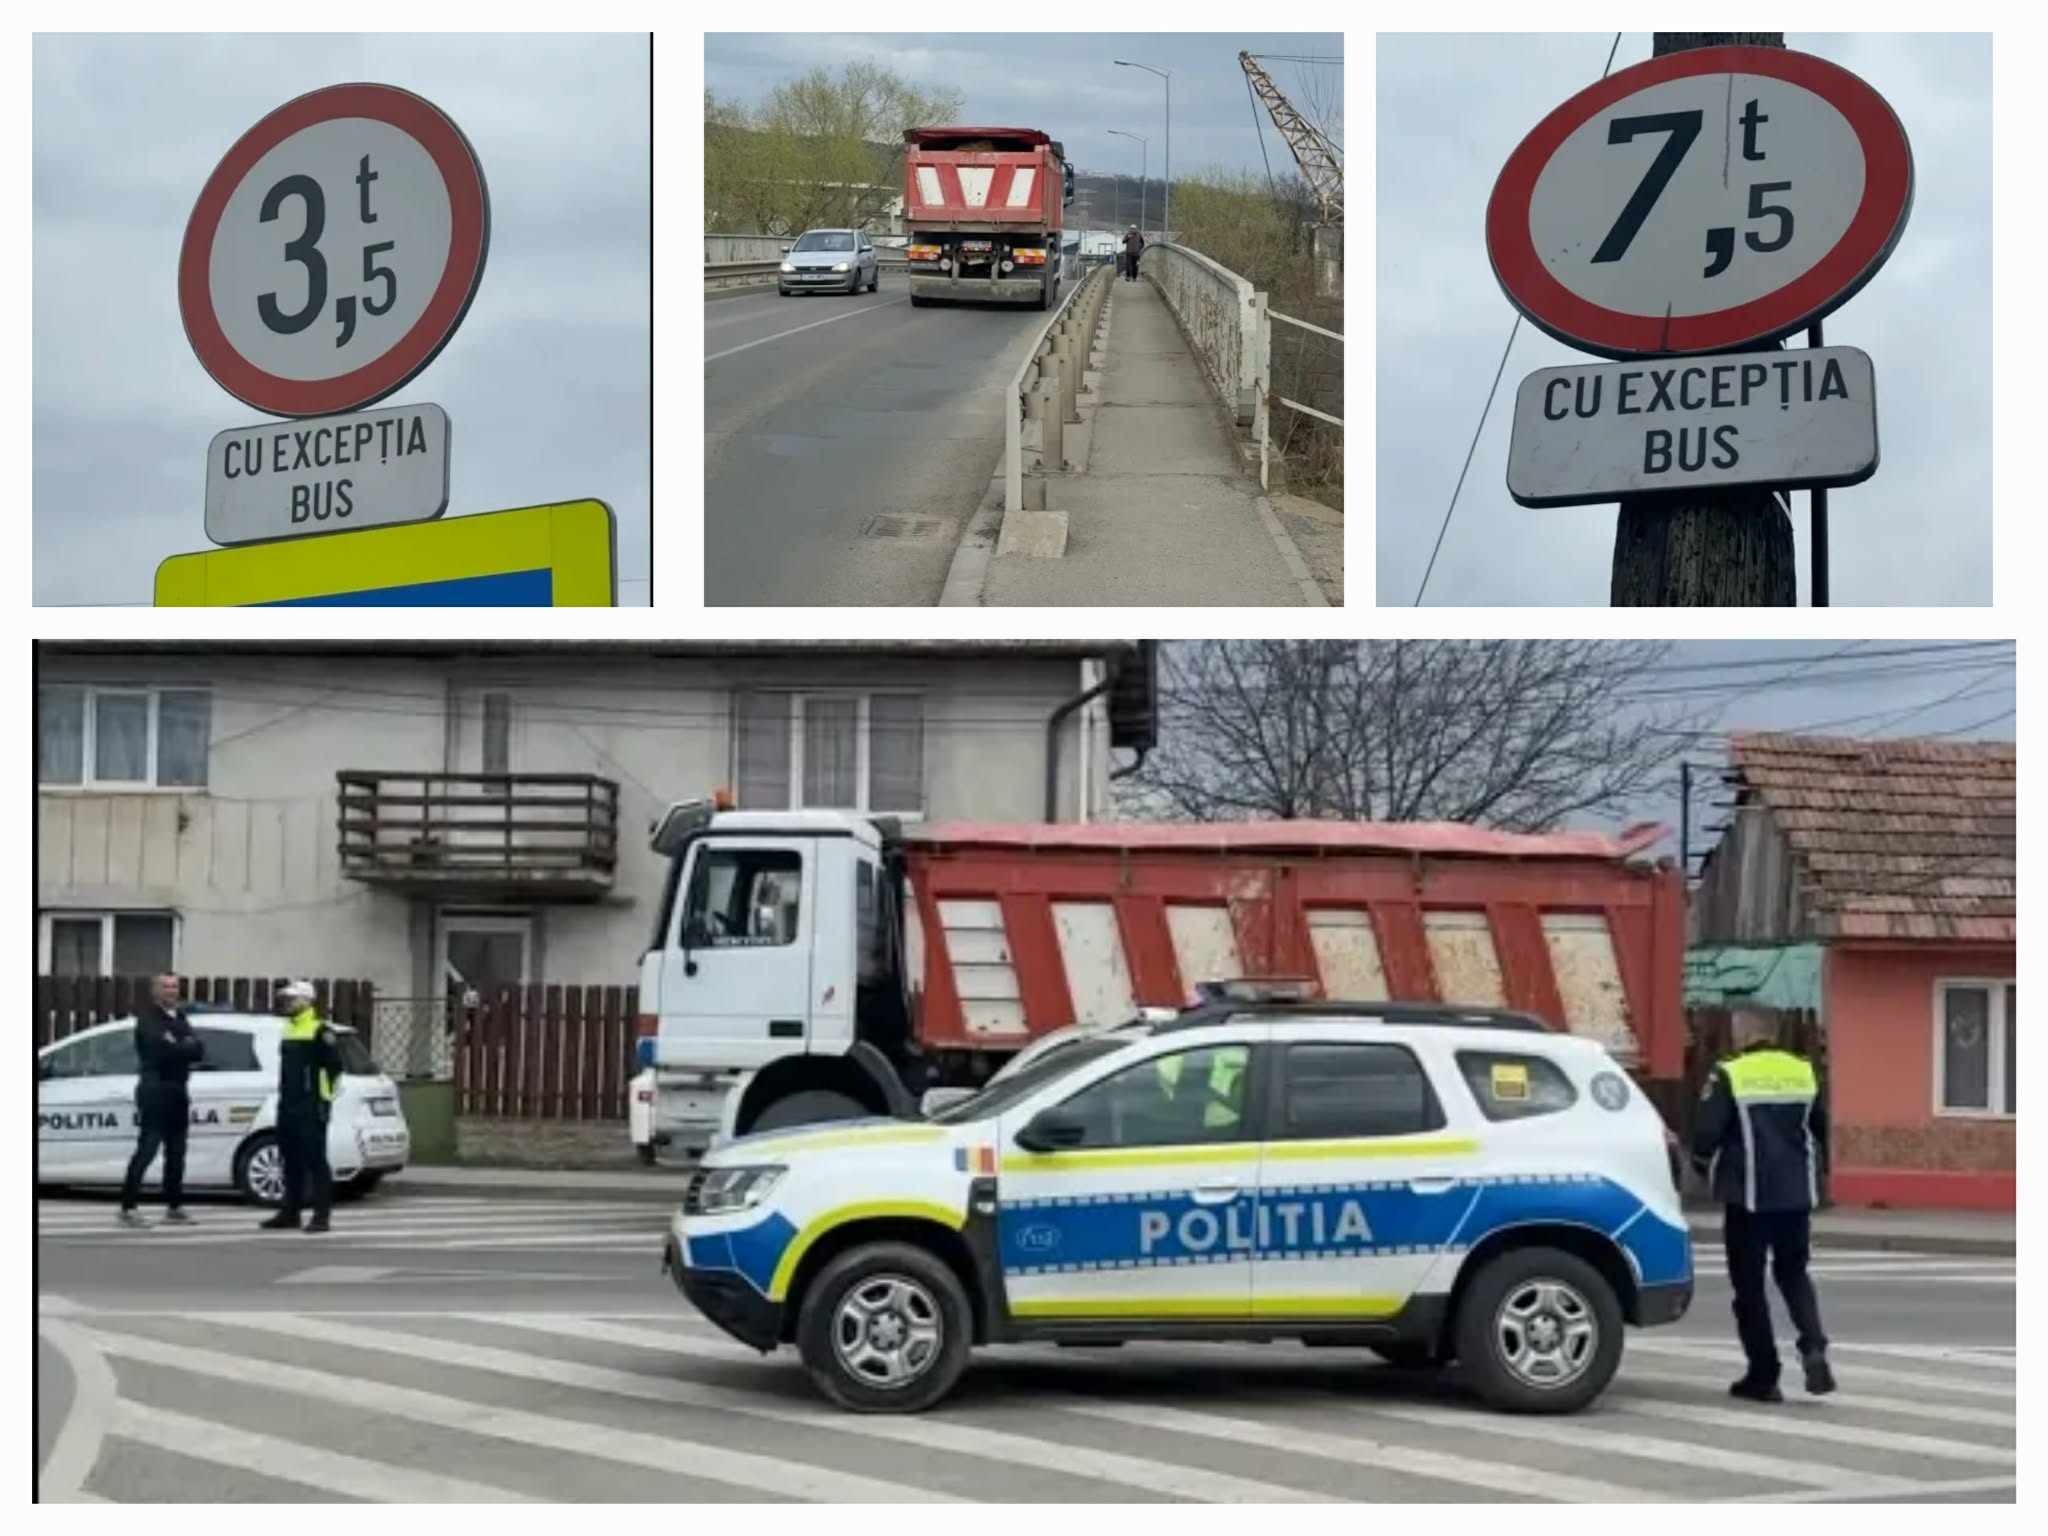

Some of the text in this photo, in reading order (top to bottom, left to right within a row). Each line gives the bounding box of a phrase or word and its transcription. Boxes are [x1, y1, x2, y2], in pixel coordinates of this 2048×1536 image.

[1739, 98, 1769, 161] t
[355, 153, 379, 224] t
[1590, 109, 1795, 279] 7,5
[257, 174, 397, 349] 3,5
[1543, 358, 1849, 421] CU EXCEPȚIA
[224, 415, 428, 479] CU EXCEPȚIA
[1643, 424, 1740, 474] BUS
[291, 478, 354, 523] BUS
[1140, 1201, 1373, 1254] POLITIA
